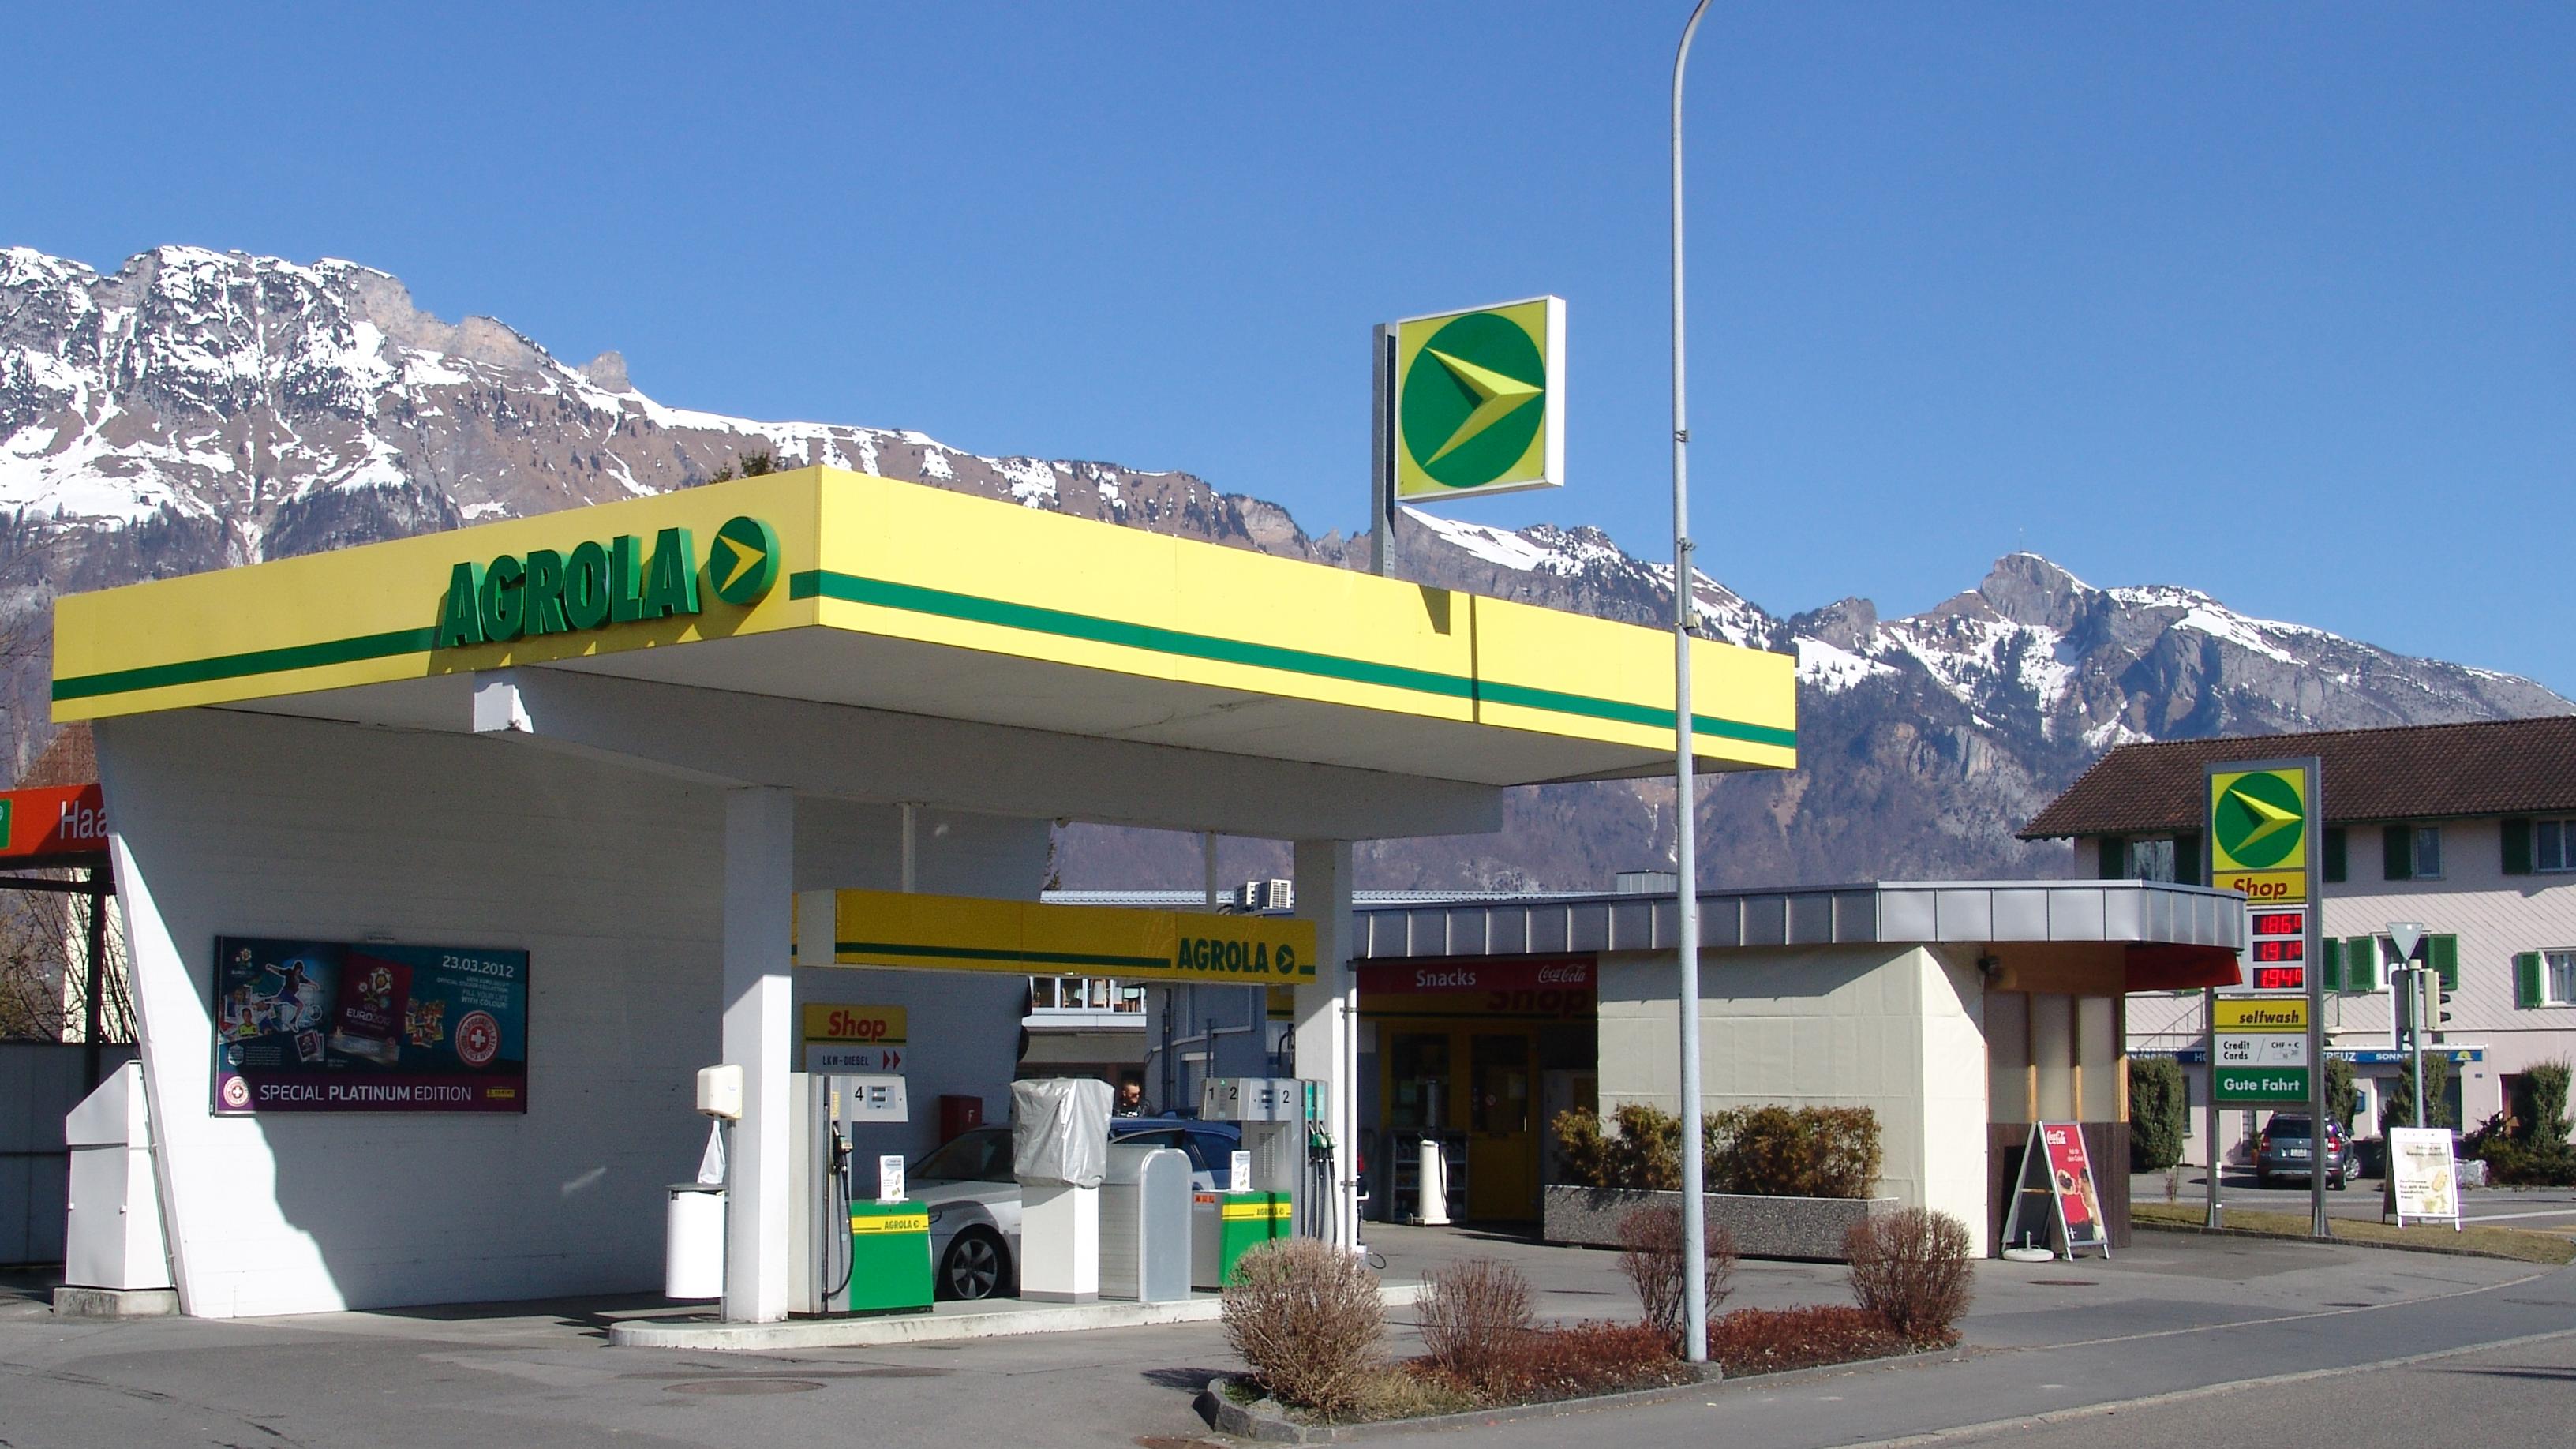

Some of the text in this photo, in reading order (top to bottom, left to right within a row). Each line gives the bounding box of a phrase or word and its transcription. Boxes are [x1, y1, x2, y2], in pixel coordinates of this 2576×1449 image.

[440, 527, 700, 648] AGROLA
[2233, 878, 2287, 900] Shop
[1178, 937, 1270, 973] AGROLA
[442, 955, 515, 978] 23.03.2012
[1416, 968, 1476, 987] Snacks
[2240, 1010, 2299, 1024] selfwash
[829, 1010, 887, 1042] Shop
[2223, 1041, 2250, 1050] Credit
[822, 1055, 869, 1065] LKW-DIESEL
[2223, 1051, 2248, 1060] Cards
[2224, 1078, 2300, 1091] Gute Fahrt
[260, 1085, 324, 1100] SPECIAL
[329, 1086, 410, 1100] PLATINUM
[414, 1086, 472, 1101] EDITION
[855, 1086, 863, 1101] 4
[1209, 1086, 1237, 1100] 1 2
[1282, 1090, 1290, 1103] 2
[968, 1109, 975, 1123] F
[884, 1220, 912, 1230] AGROLA
